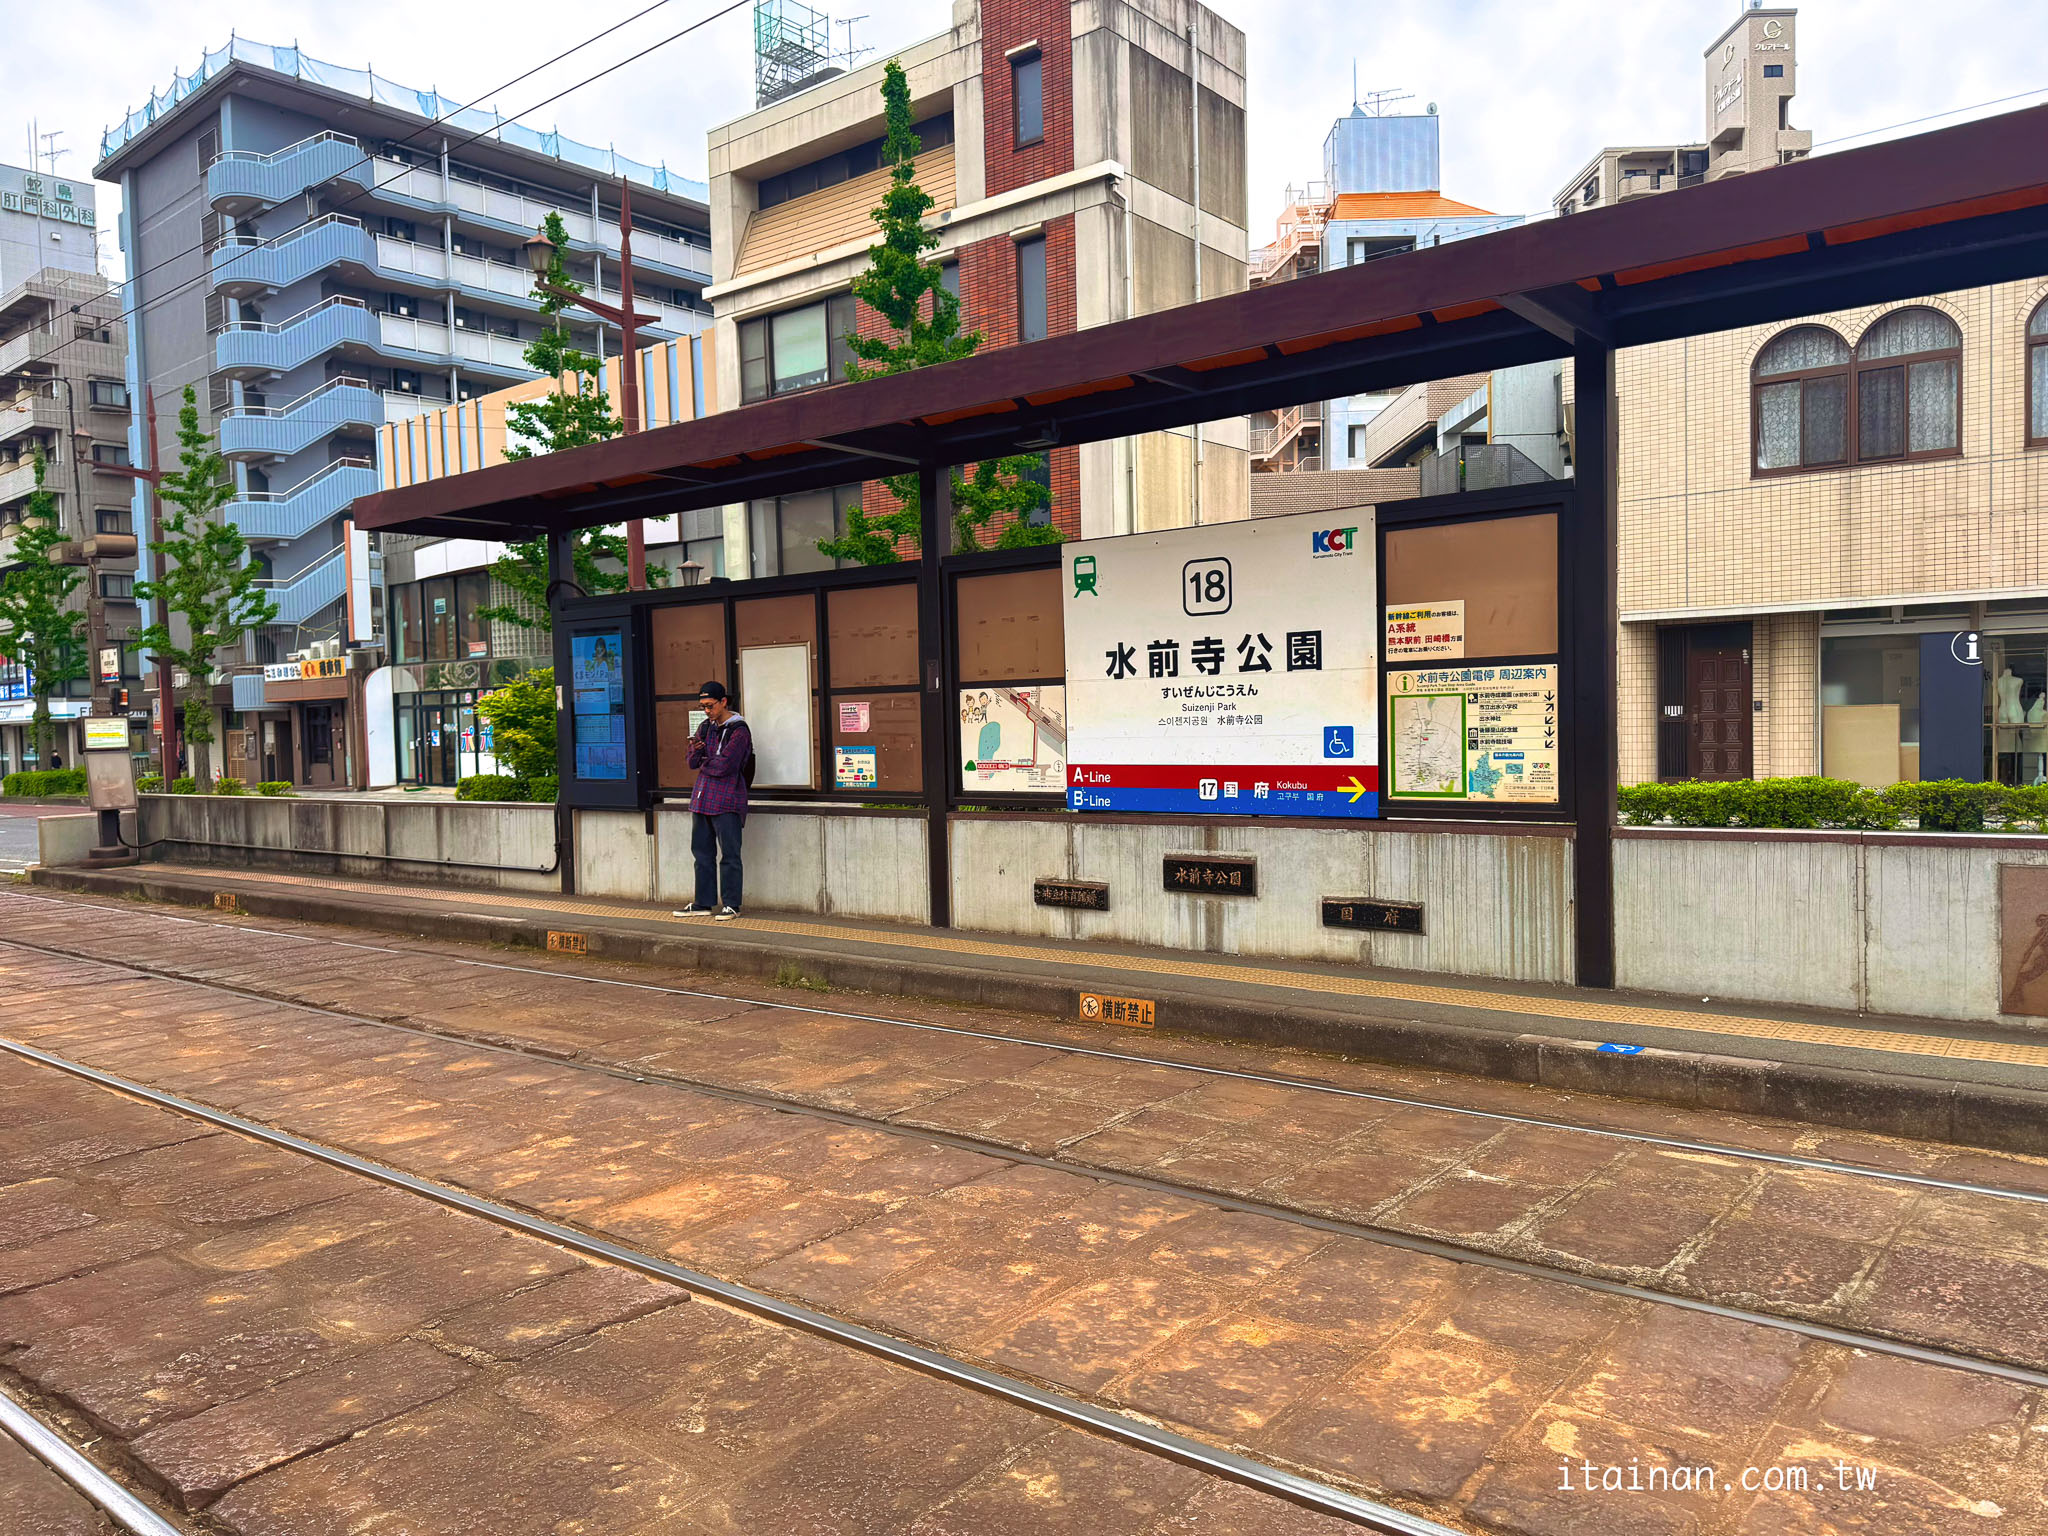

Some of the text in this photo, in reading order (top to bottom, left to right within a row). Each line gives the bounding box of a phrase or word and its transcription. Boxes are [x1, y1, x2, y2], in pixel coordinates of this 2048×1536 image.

[1312, 526, 1358, 553] KCT
[1189, 569, 1226, 603] 18
[1388, 622, 1416, 634] A系統
[1105, 630, 1323, 680] 水前寺公園
[1417, 668, 1547, 684] 水前寺公園電停 周辺案内
[1161, 683, 1259, 699] すいぜんじこうえん
[1181, 702, 1237, 712] Suizenji Park
[1073, 767, 1111, 783] A-Line
[1201, 782, 1216, 796] 17
[1276, 781, 1308, 790] Kokubu
[1073, 790, 1111, 807] B-Line
[1174, 866, 1242, 887] 水前寺公園
[1101, 998, 1153, 1026] 横断禁止
